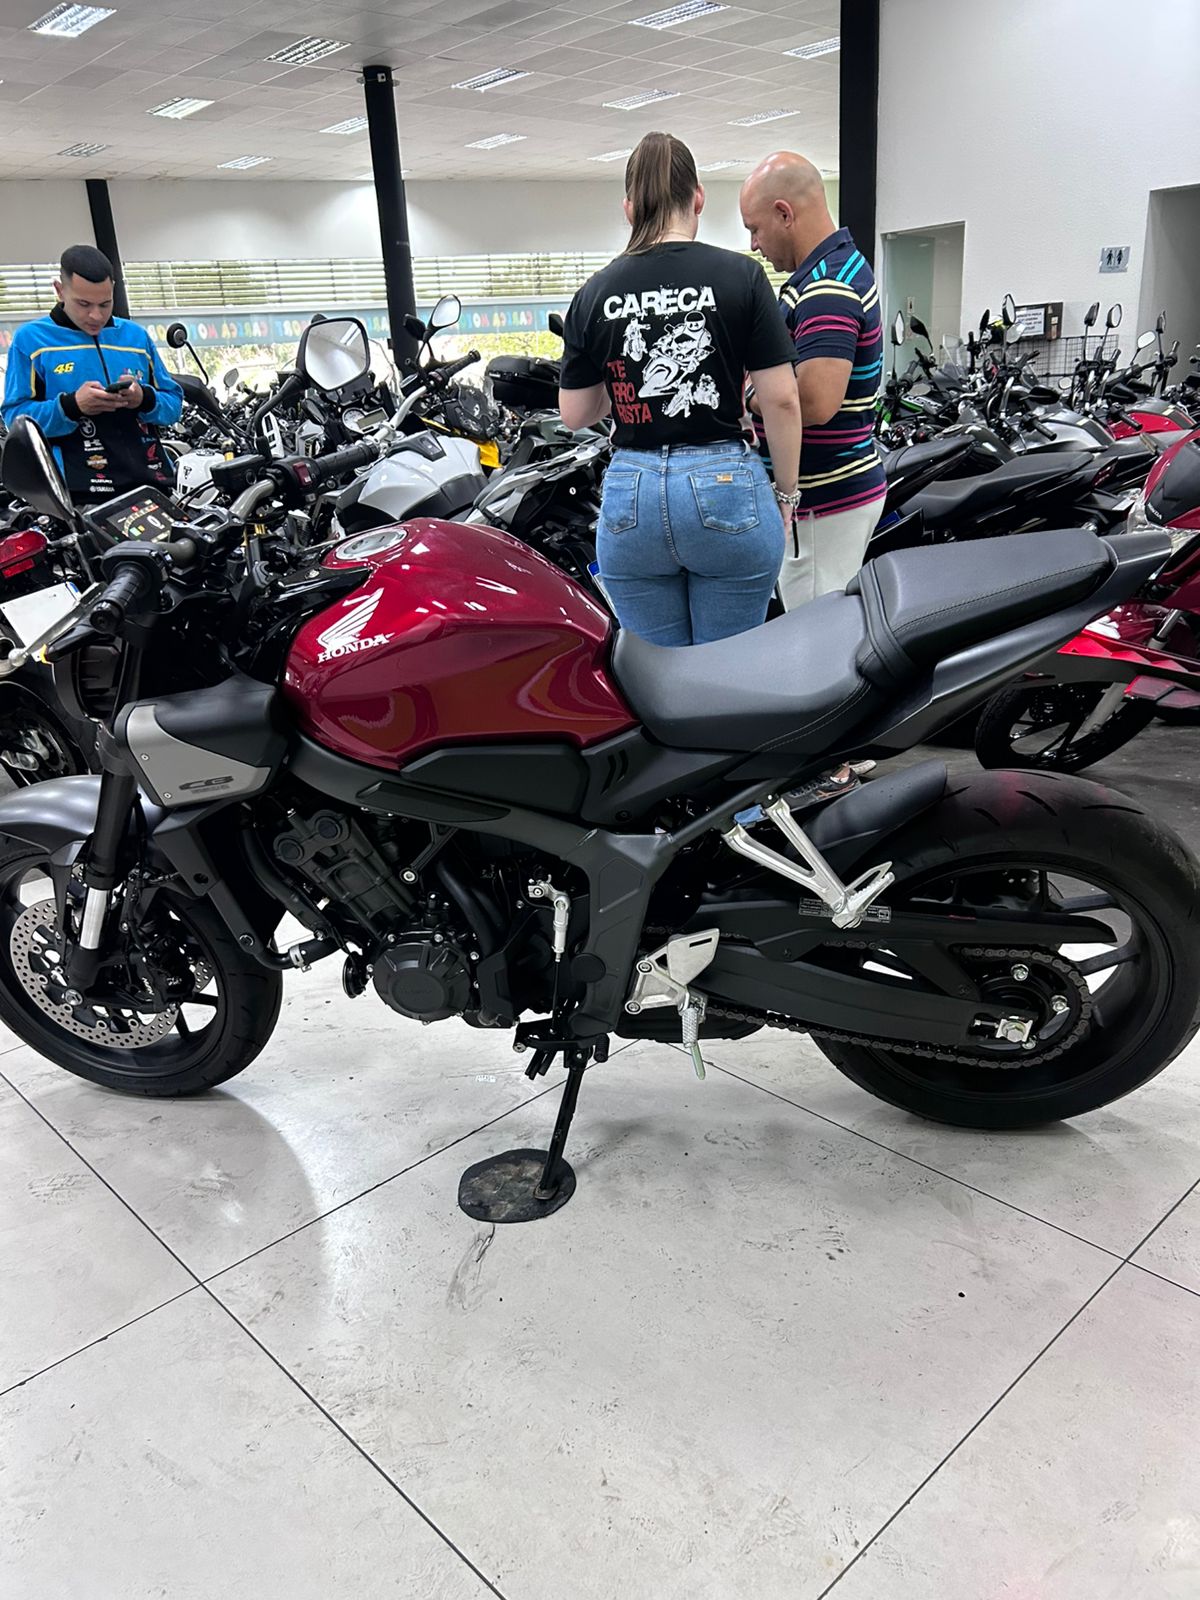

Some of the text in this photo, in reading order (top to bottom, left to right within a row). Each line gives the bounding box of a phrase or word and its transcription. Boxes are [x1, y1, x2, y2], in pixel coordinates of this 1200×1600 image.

[603, 286, 716, 320] CARECA
[54, 362, 75, 374] 46
[317, 633, 390, 664] HONDA
[179, 775, 234, 790] CB
